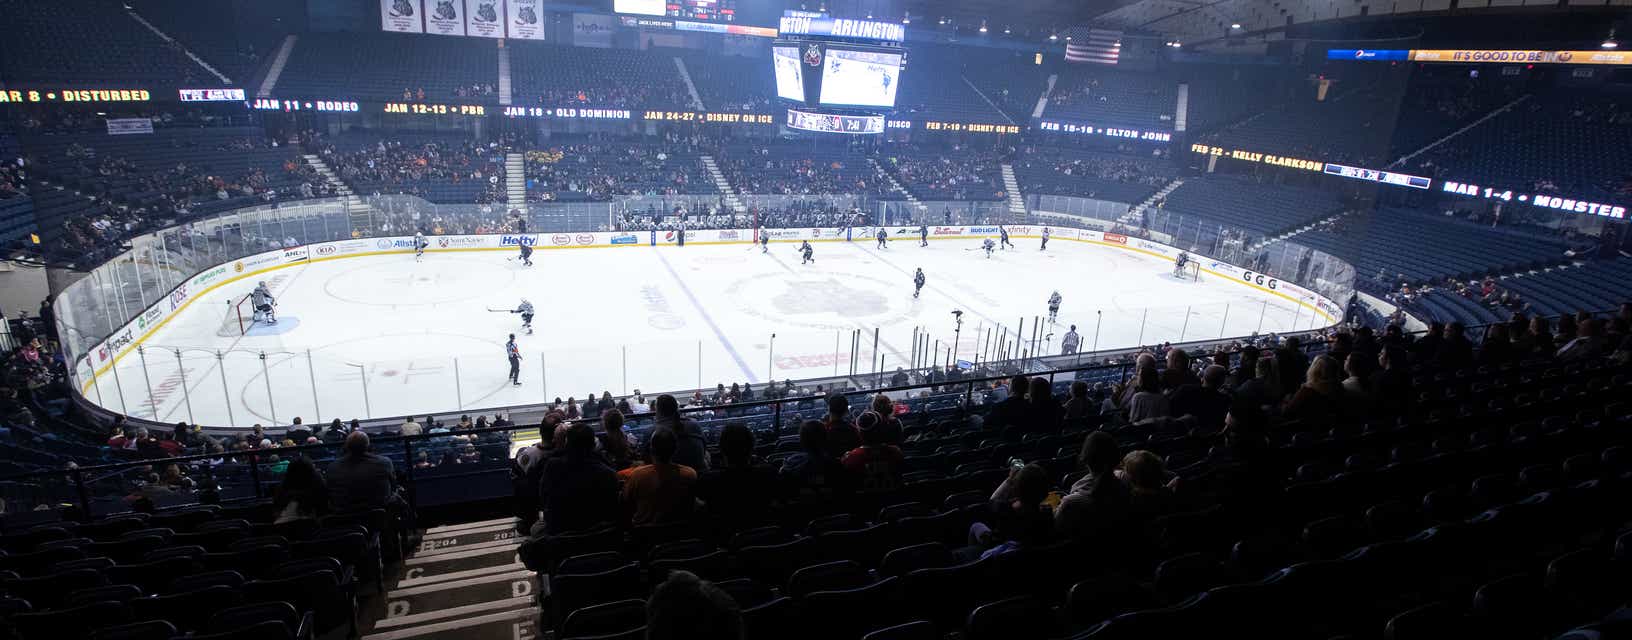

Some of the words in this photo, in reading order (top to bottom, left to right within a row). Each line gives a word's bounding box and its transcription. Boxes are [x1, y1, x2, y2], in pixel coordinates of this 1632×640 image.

[831, 19, 899, 40] ARLINGTON
[1473, 51, 1508, 61] GOOD
[1510, 51, 1526, 61] TO
[1527, 51, 1541, 62] BE
[28, 90, 40, 102] 8
[62, 90, 150, 101] DISTURBED
[253, 99, 280, 110] JAN
[284, 100, 300, 110] 11
[317, 101, 359, 112] RODEO
[384, 103, 408, 113] JAN
[412, 104, 447, 113] 12-13
[460, 105, 485, 115] PBR
[504, 106, 526, 116] JAN
[529, 107, 543, 117] 18
[556, 108, 576, 118] OLD
[579, 109, 631, 119] DOMINION
[643, 111, 663, 120] JAN
[666, 111, 695, 121] 24-27
[706, 113, 740, 122] DISNEY
[742, 114, 755, 122] ON
[757, 115, 773, 123] ICE
[887, 120, 911, 128] DISCO
[926, 122, 940, 130] FEB
[968, 124, 994, 132] DISNEY
[1008, 125, 1019, 133] ICE
[1040, 121, 1060, 130] FEB
[1106, 128, 1138, 138] ELTON
[1141, 131, 1170, 141] JOHN
[1191, 144, 1209, 154] FEB
[1210, 147, 1223, 156] 22
[1232, 150, 1262, 162] KELLY
[1264, 154, 1323, 171] CLARKSON
[1443, 181, 1479, 196] MAR
[1483, 188, 1512, 201] 1-4
[1533, 195, 1626, 218] MONSTER
[1007, 226, 1032, 237] xfinity
[501, 235, 536, 246] Hefty
[1243, 271, 1252, 282] G
[1255, 275, 1265, 286] G
[1267, 279, 1277, 290] G
[511, 580, 531, 597] D
